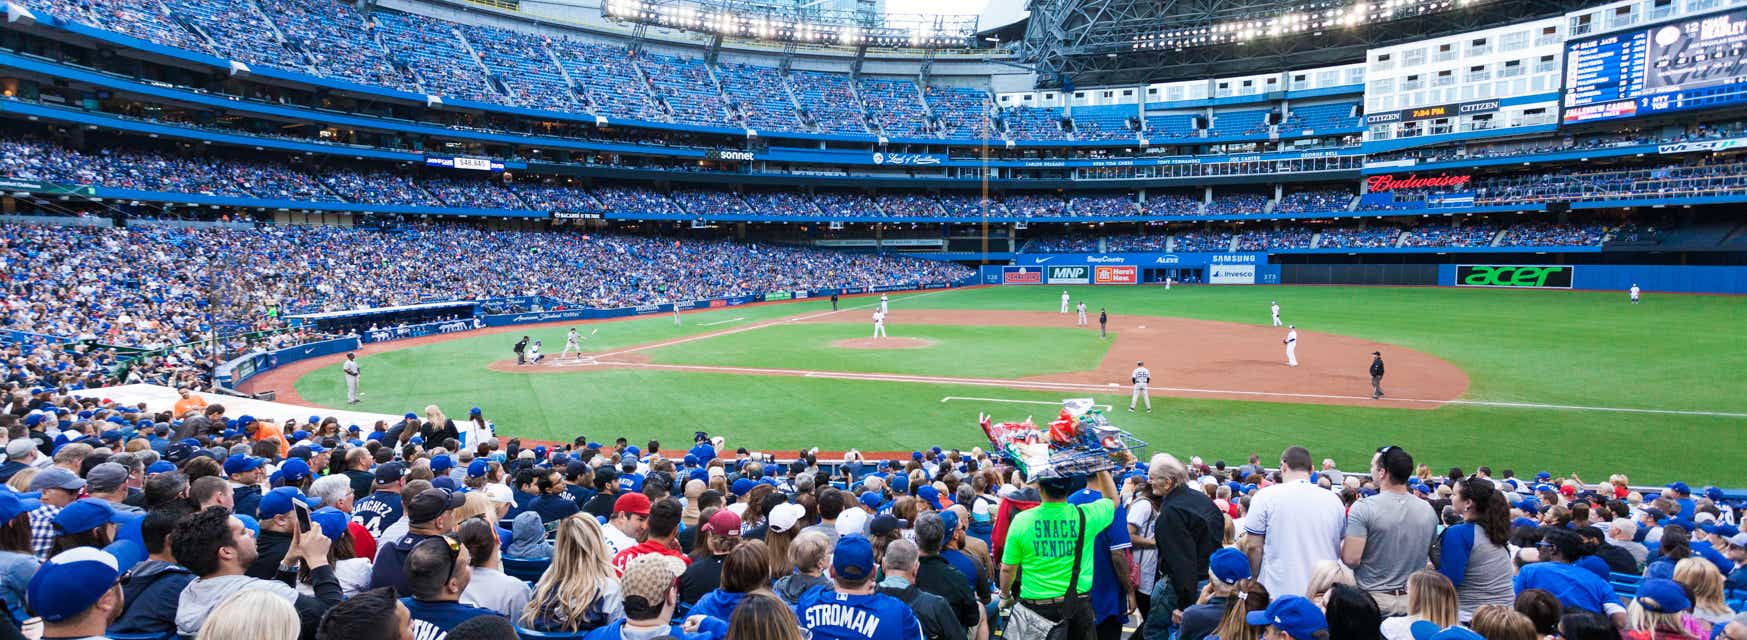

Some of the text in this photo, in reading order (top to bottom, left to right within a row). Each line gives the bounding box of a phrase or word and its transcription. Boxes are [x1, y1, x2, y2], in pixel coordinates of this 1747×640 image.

[1685, 22, 1699, 34] 12
[1600, 36, 1618, 46] JAYS
[1431, 106, 1445, 115] PM
[1461, 102, 1498, 113] CITIZEN
[1367, 113, 1400, 122] CITIZEN
[720, 151, 754, 160] sonnet
[1367, 172, 1471, 192] Budweiser
[1053, 267, 1084, 279] MNP
[1464, 265, 1563, 287] acer
[635, 304, 659, 312] HONDA
[1034, 519, 1078, 539] SNACK
[1033, 541, 1078, 558] VENDO
[805, 603, 880, 639] STROMAN
